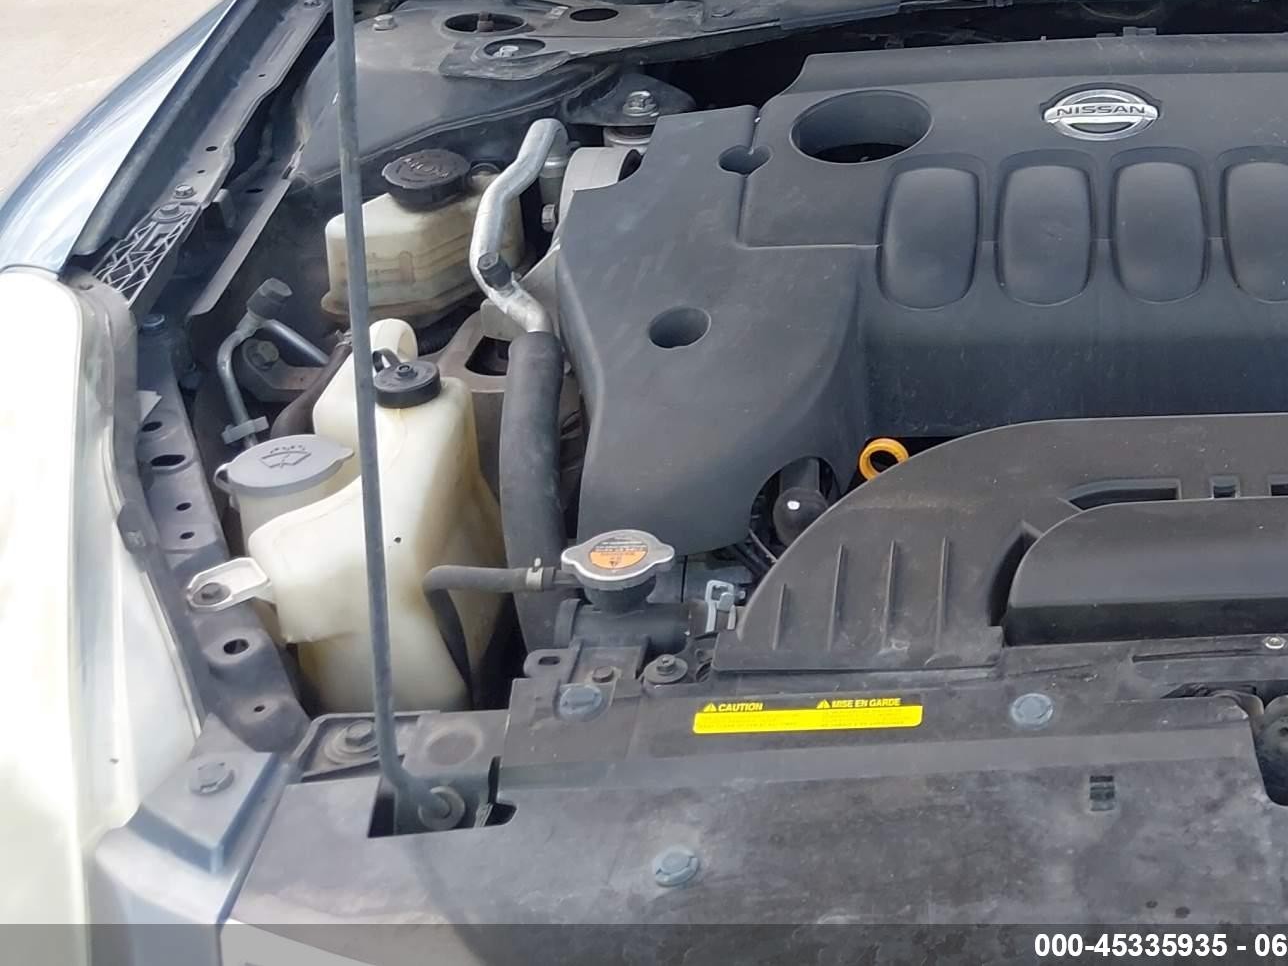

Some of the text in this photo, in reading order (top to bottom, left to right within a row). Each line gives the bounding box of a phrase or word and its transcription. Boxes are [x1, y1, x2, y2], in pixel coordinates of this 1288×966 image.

[1056, 105, 1145, 116] NISSAN
[717, 702, 764, 712] CAUTION
[832, 698, 901, 708] MISE EN GARDE
